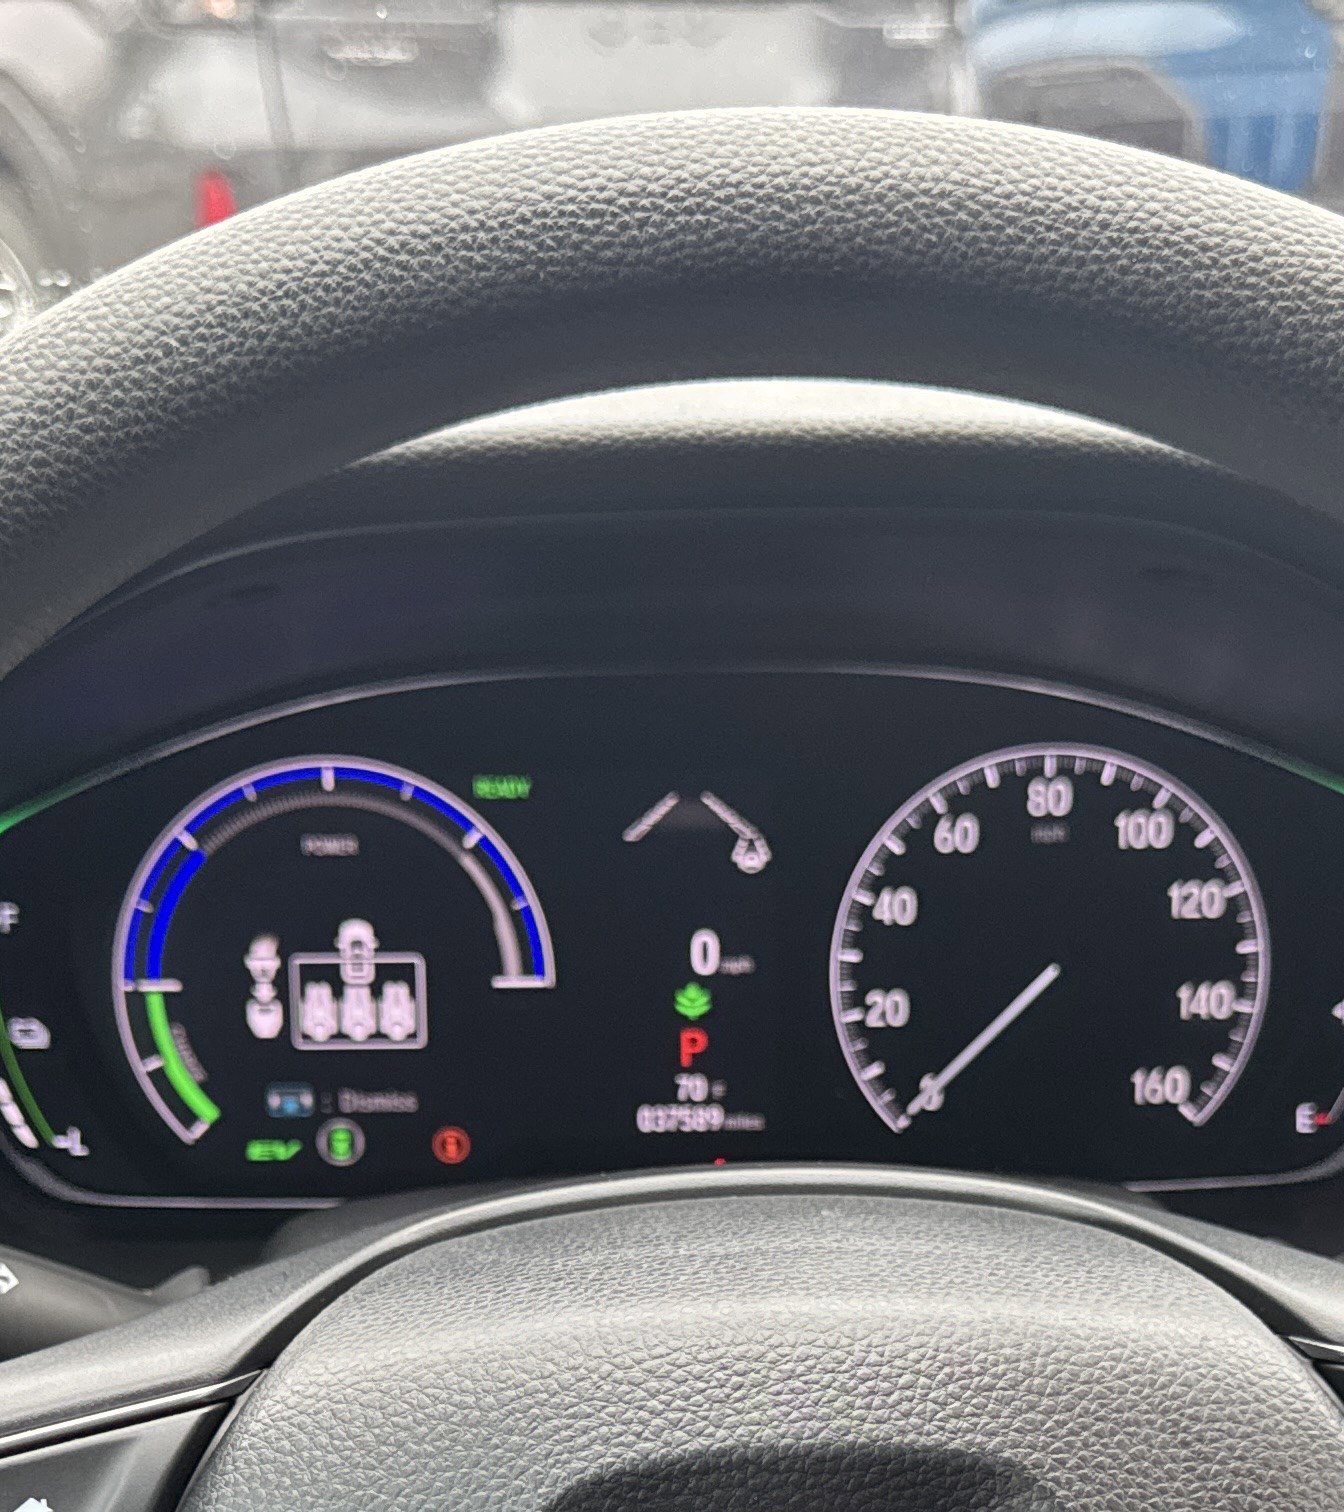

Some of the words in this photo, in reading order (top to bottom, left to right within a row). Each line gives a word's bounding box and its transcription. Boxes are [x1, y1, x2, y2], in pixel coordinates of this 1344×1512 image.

[1027, 776, 1074, 817] 80
[933, 812, 980, 854] 60
[1114, 808, 1175, 849] 100
[872, 886, 918, 926] 40
[1168, 879, 1227, 919] 120
[690, 928, 721, 976] 0
[865, 988, 911, 1027] 20
[1176, 980, 1236, 1020] 140
[680, 1028, 709, 1068] P
[674, 1073, 708, 1102] 70
[1130, 1066, 1191, 1105] 160
